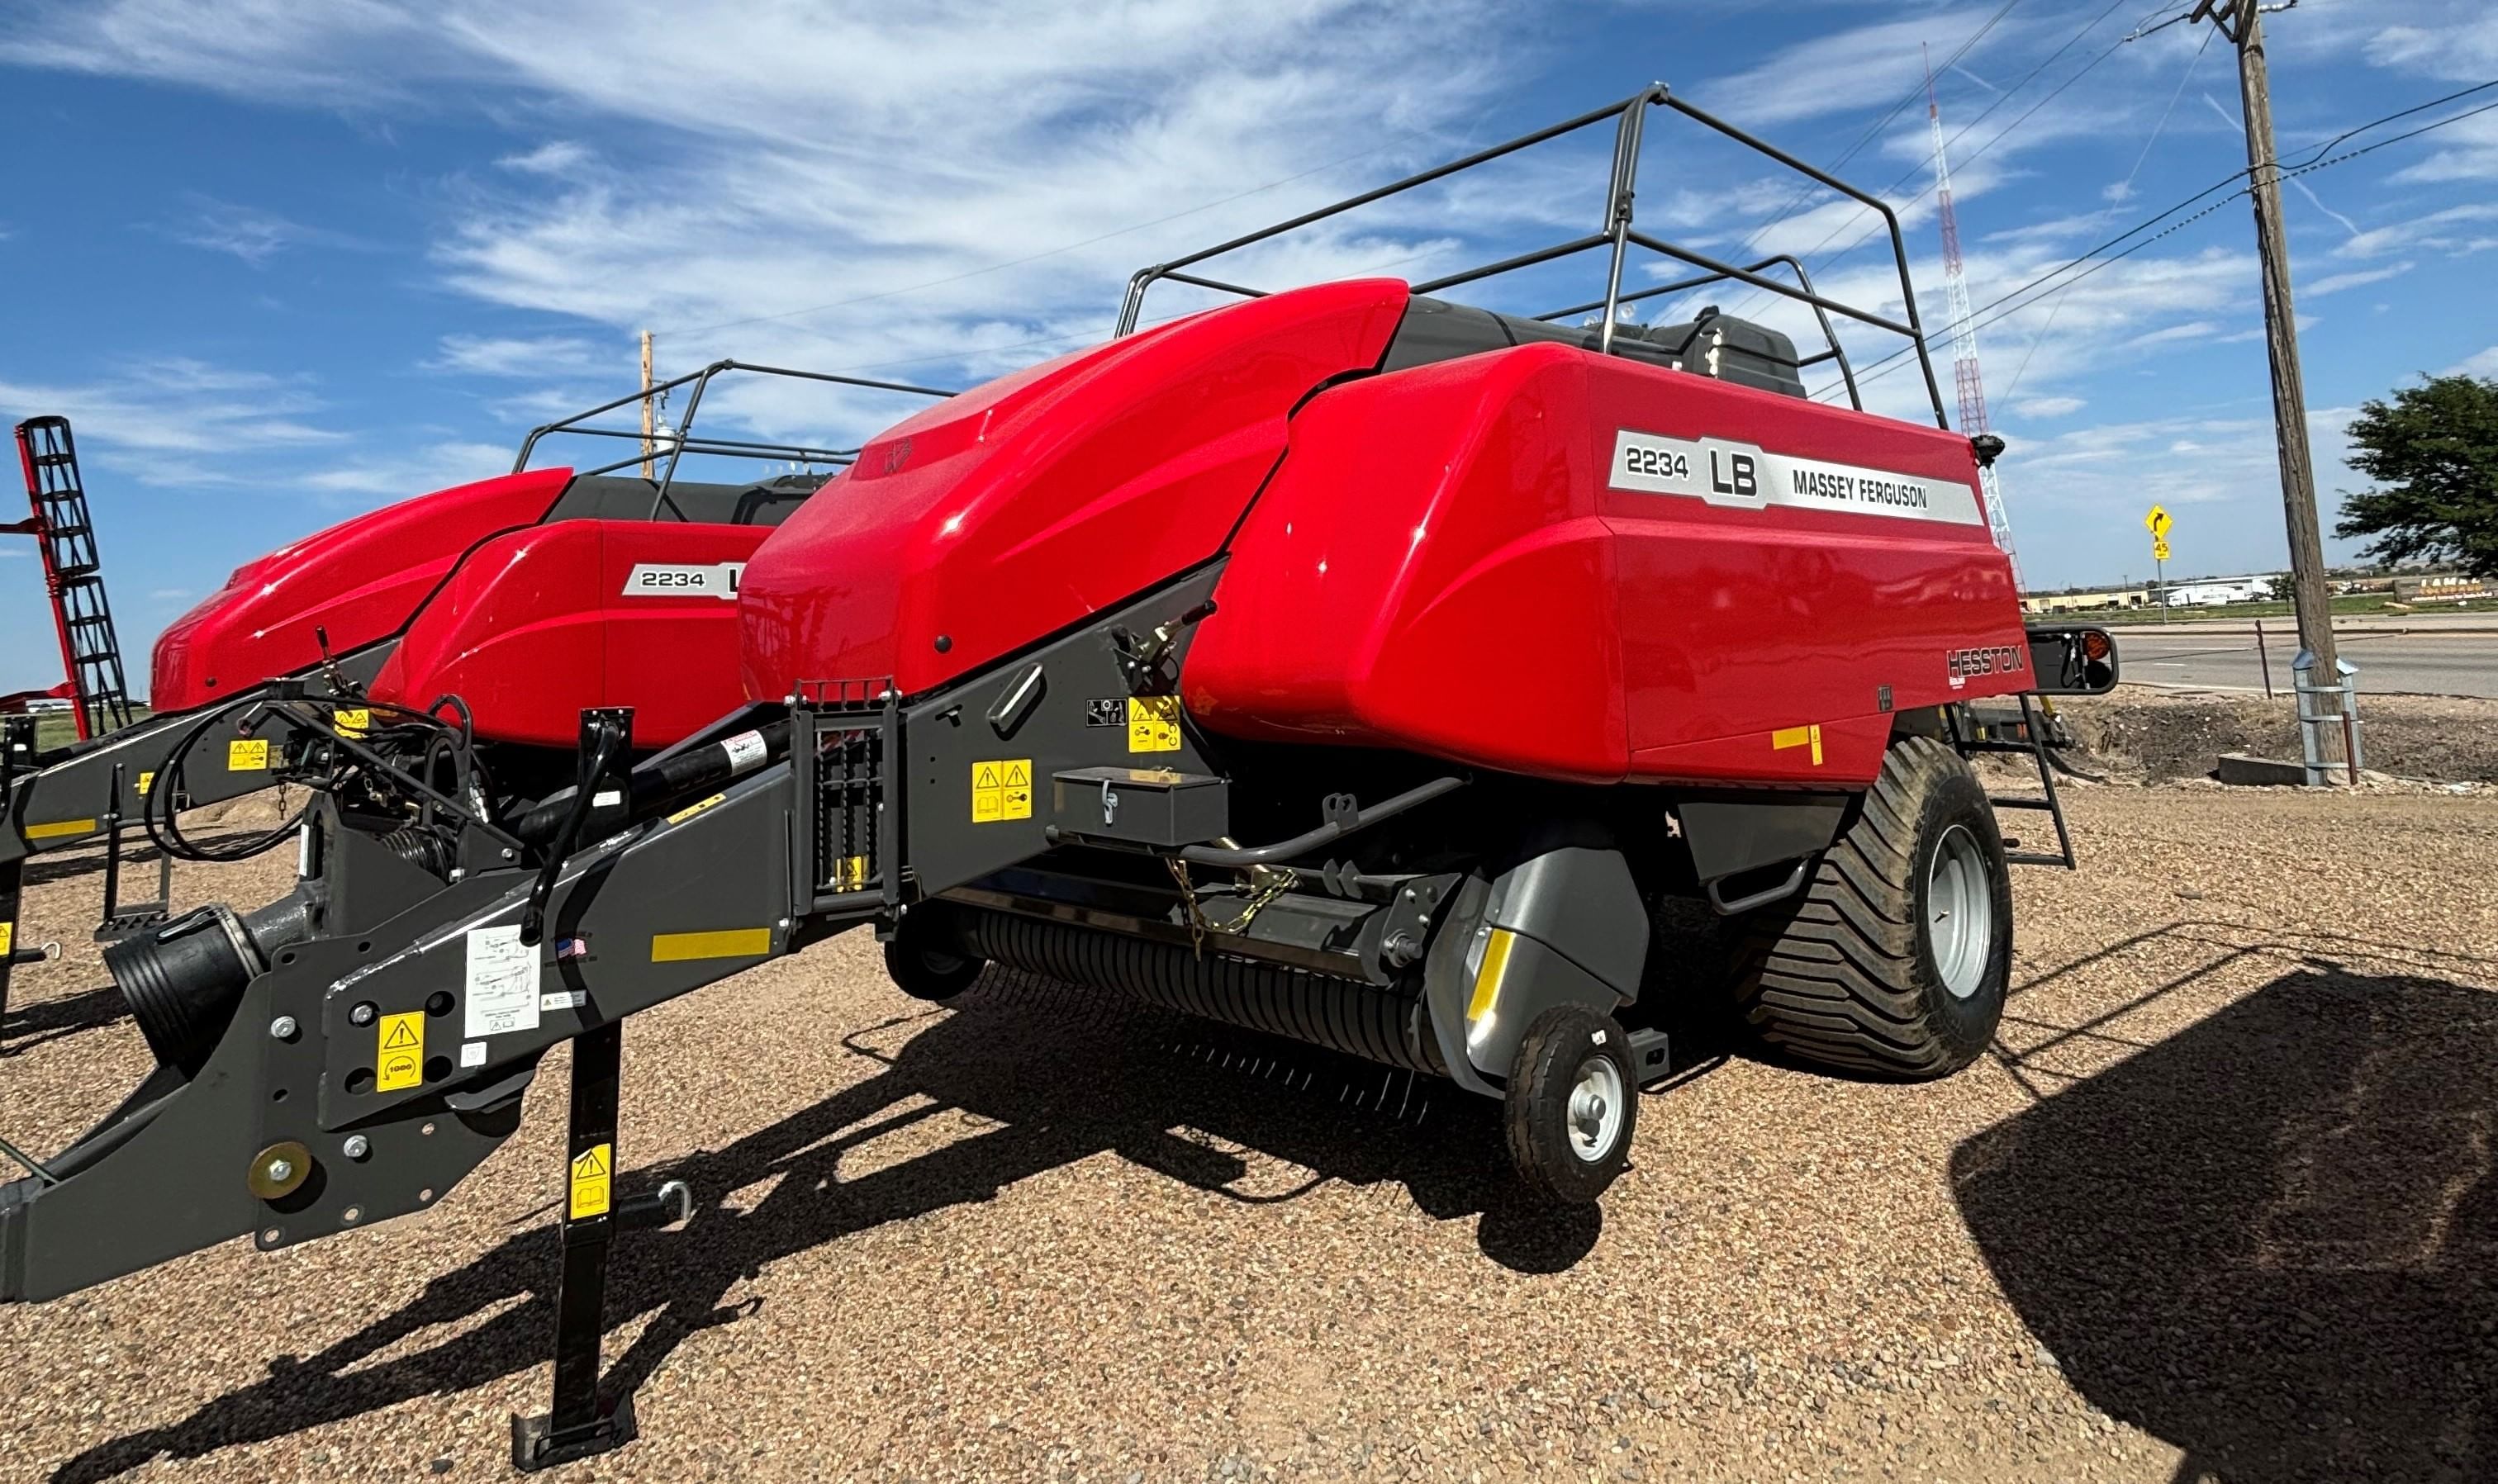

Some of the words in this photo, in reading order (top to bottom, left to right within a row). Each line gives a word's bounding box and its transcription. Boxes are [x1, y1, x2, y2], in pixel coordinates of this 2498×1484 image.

[1626, 448, 1688, 479] 2234
[1710, 450, 1757, 497] LB
[1793, 469, 1854, 500] MASSEY
[1859, 479, 1927, 509] FERGUSON
[2155, 543, 2168, 552] 45
[641, 571, 705, 586] 2234
[1947, 646, 2024, 677] HESSTON
